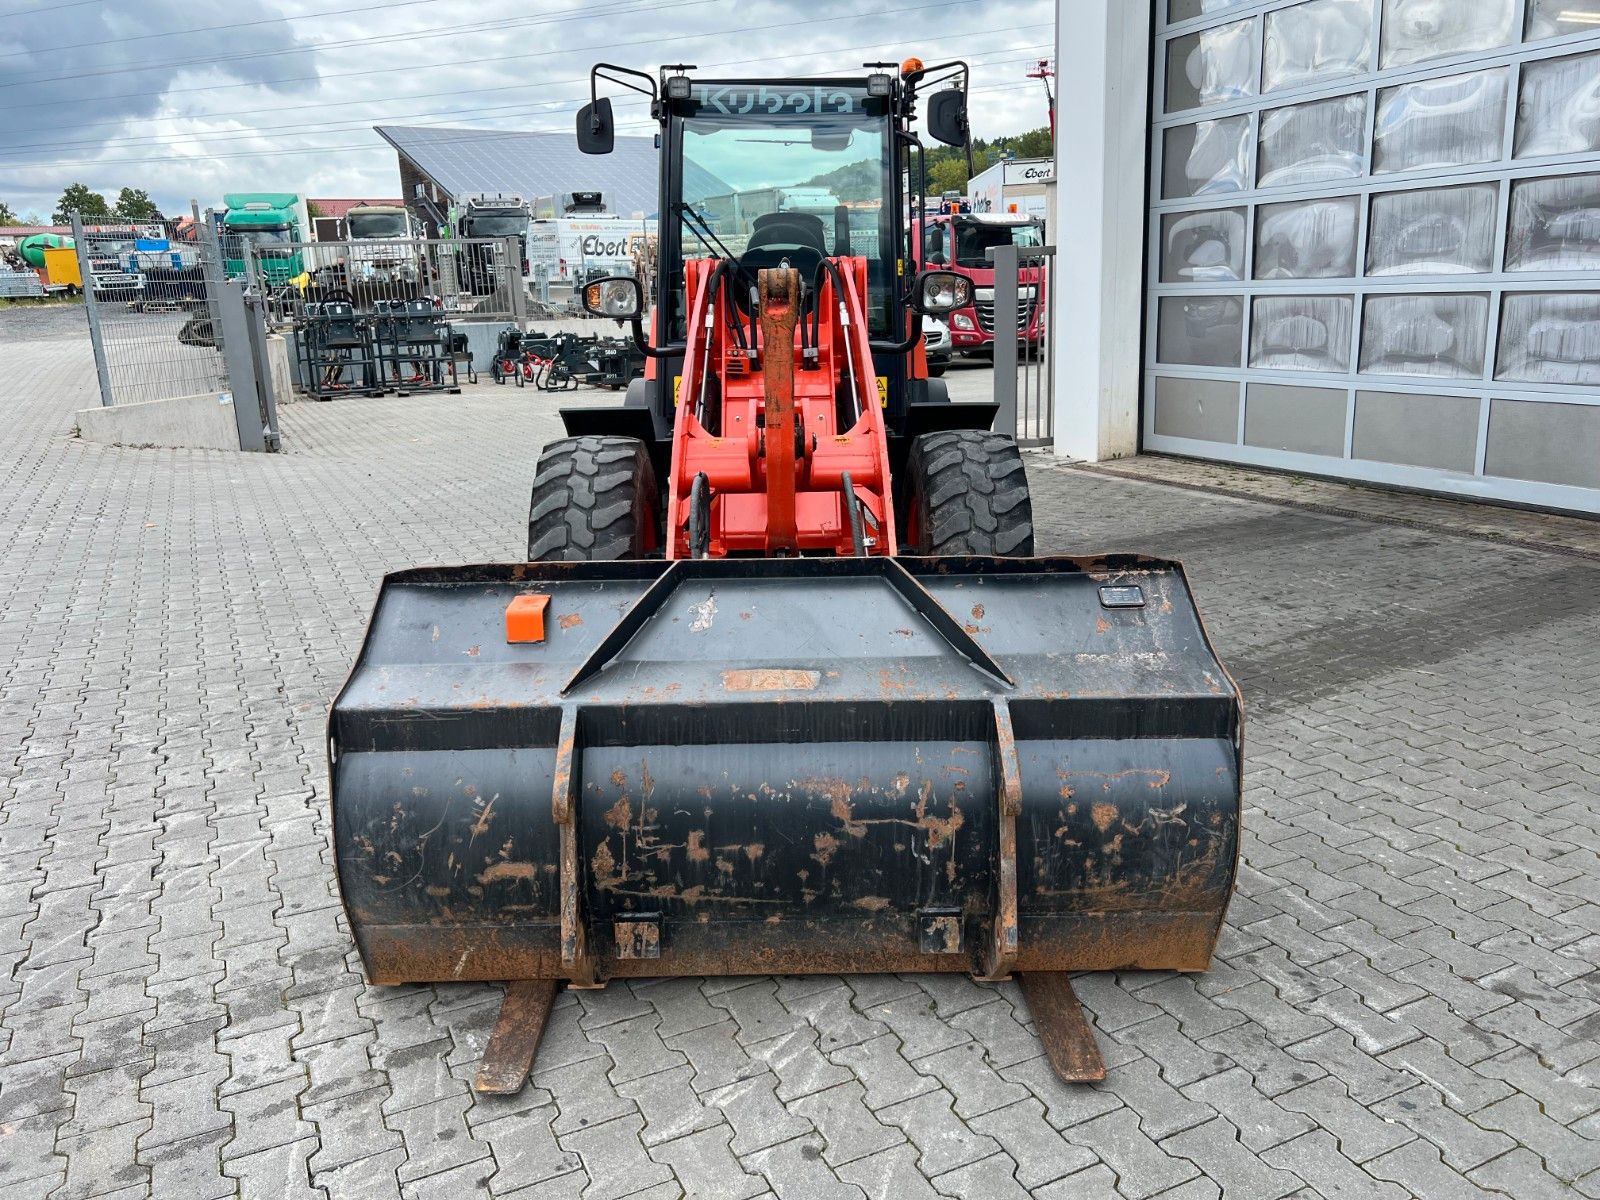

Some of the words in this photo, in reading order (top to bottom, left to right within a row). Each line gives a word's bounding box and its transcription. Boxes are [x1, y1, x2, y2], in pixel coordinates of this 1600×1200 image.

[700, 86, 853, 114] Kubota
[1024, 168, 1051, 179] Ebert
[583, 235, 627, 256] Ebert
